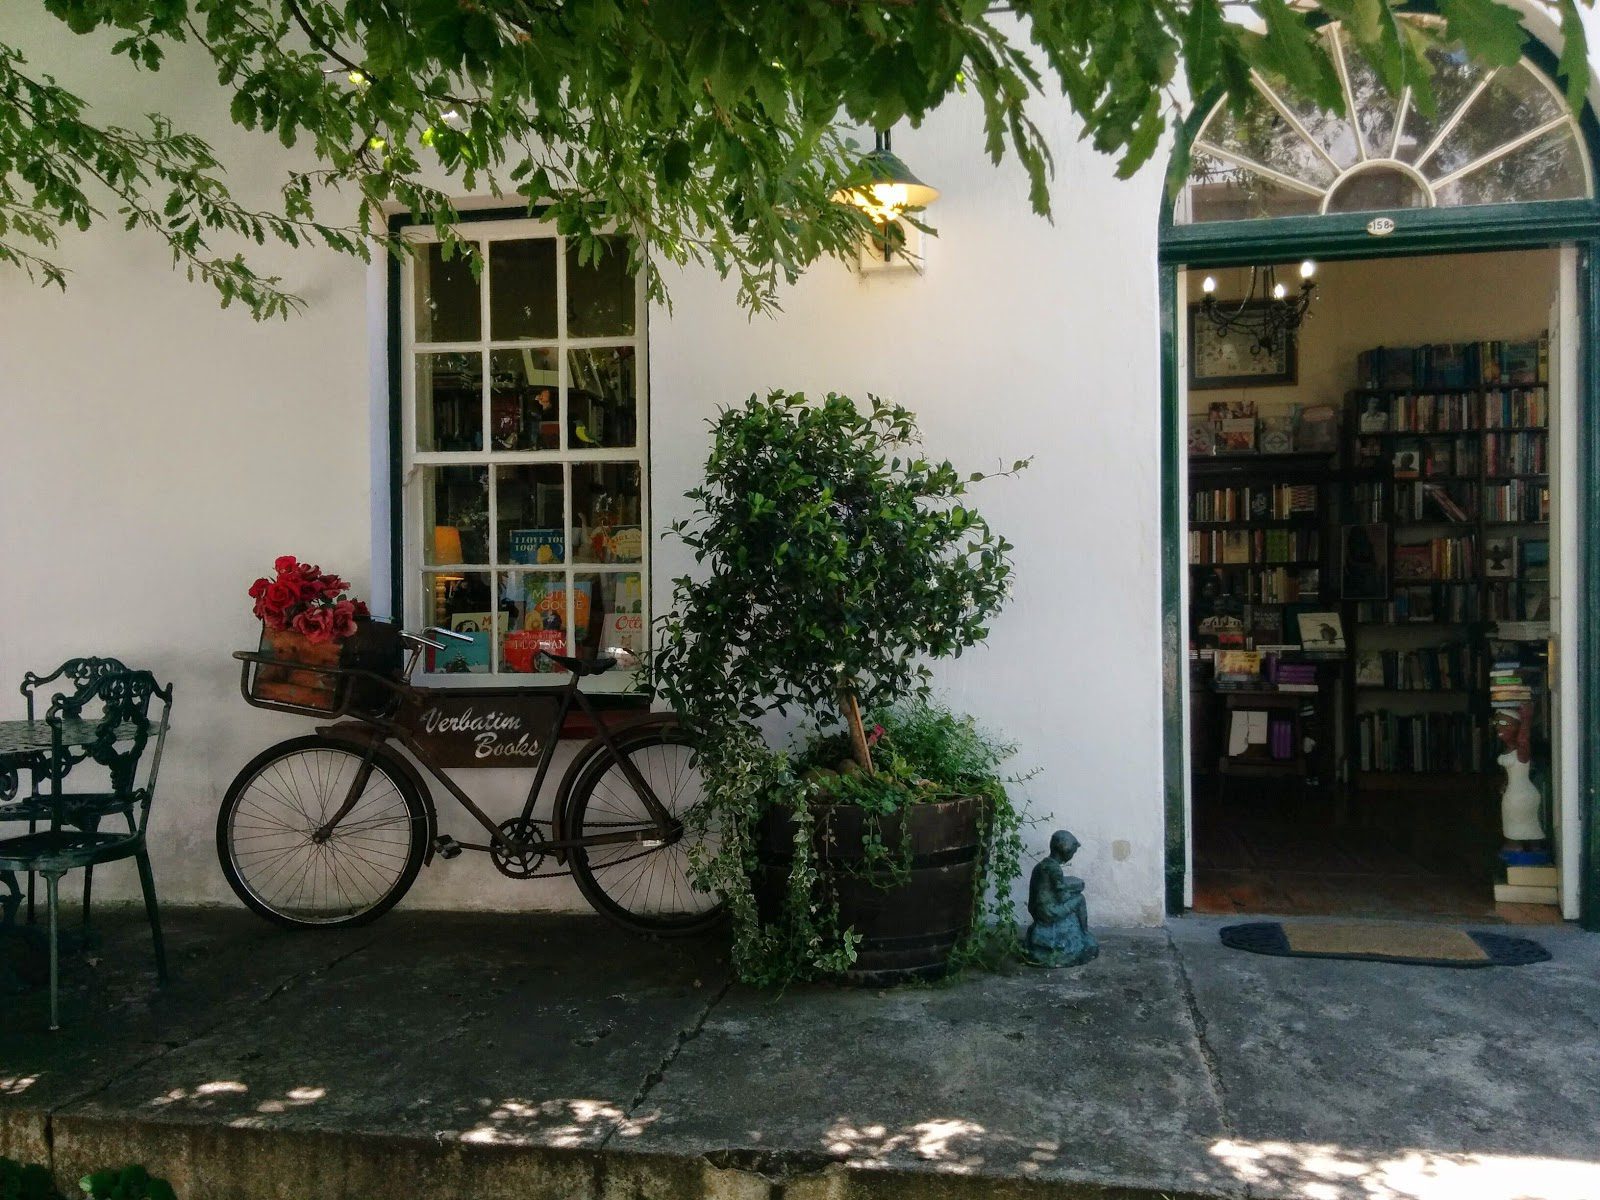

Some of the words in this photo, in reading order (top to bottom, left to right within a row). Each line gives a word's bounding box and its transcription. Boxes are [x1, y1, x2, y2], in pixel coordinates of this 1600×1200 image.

[1373, 220, 1390, 231] 158
[420, 706, 522, 733] Verbatim
[474, 731, 542, 759] Books
